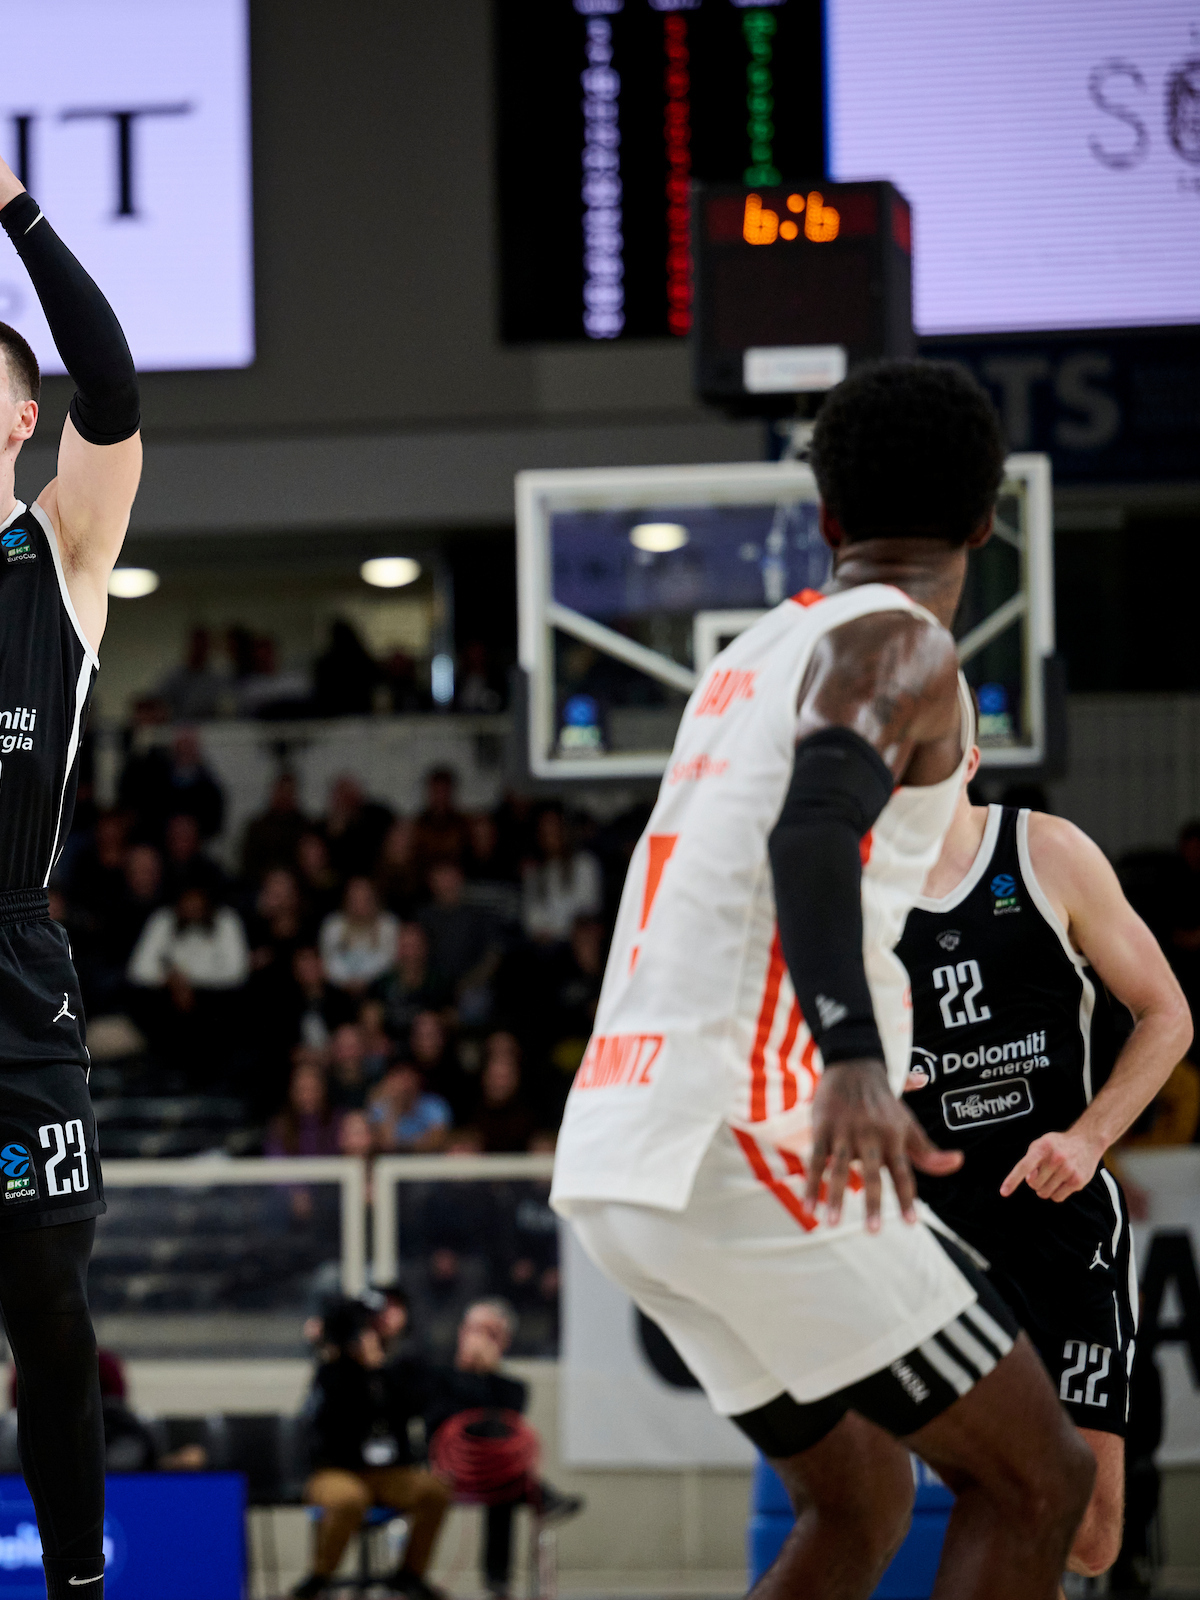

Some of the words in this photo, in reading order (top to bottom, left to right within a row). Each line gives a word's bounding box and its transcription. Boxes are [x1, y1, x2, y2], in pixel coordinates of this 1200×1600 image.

[6, 553, 37, 563] EuroCup
[932, 959, 992, 1029] 22
[942, 1030, 1046, 1075] Dolomiti
[979, 1054, 1050, 1079] energia
[951, 1091, 1022, 1119] TRENTINO
[38, 1119, 90, 1197] 23
[4, 1188, 36, 1200] EuroCup
[7, 1178, 30, 1190] BKT
[1059, 1338, 1112, 1408] 22
